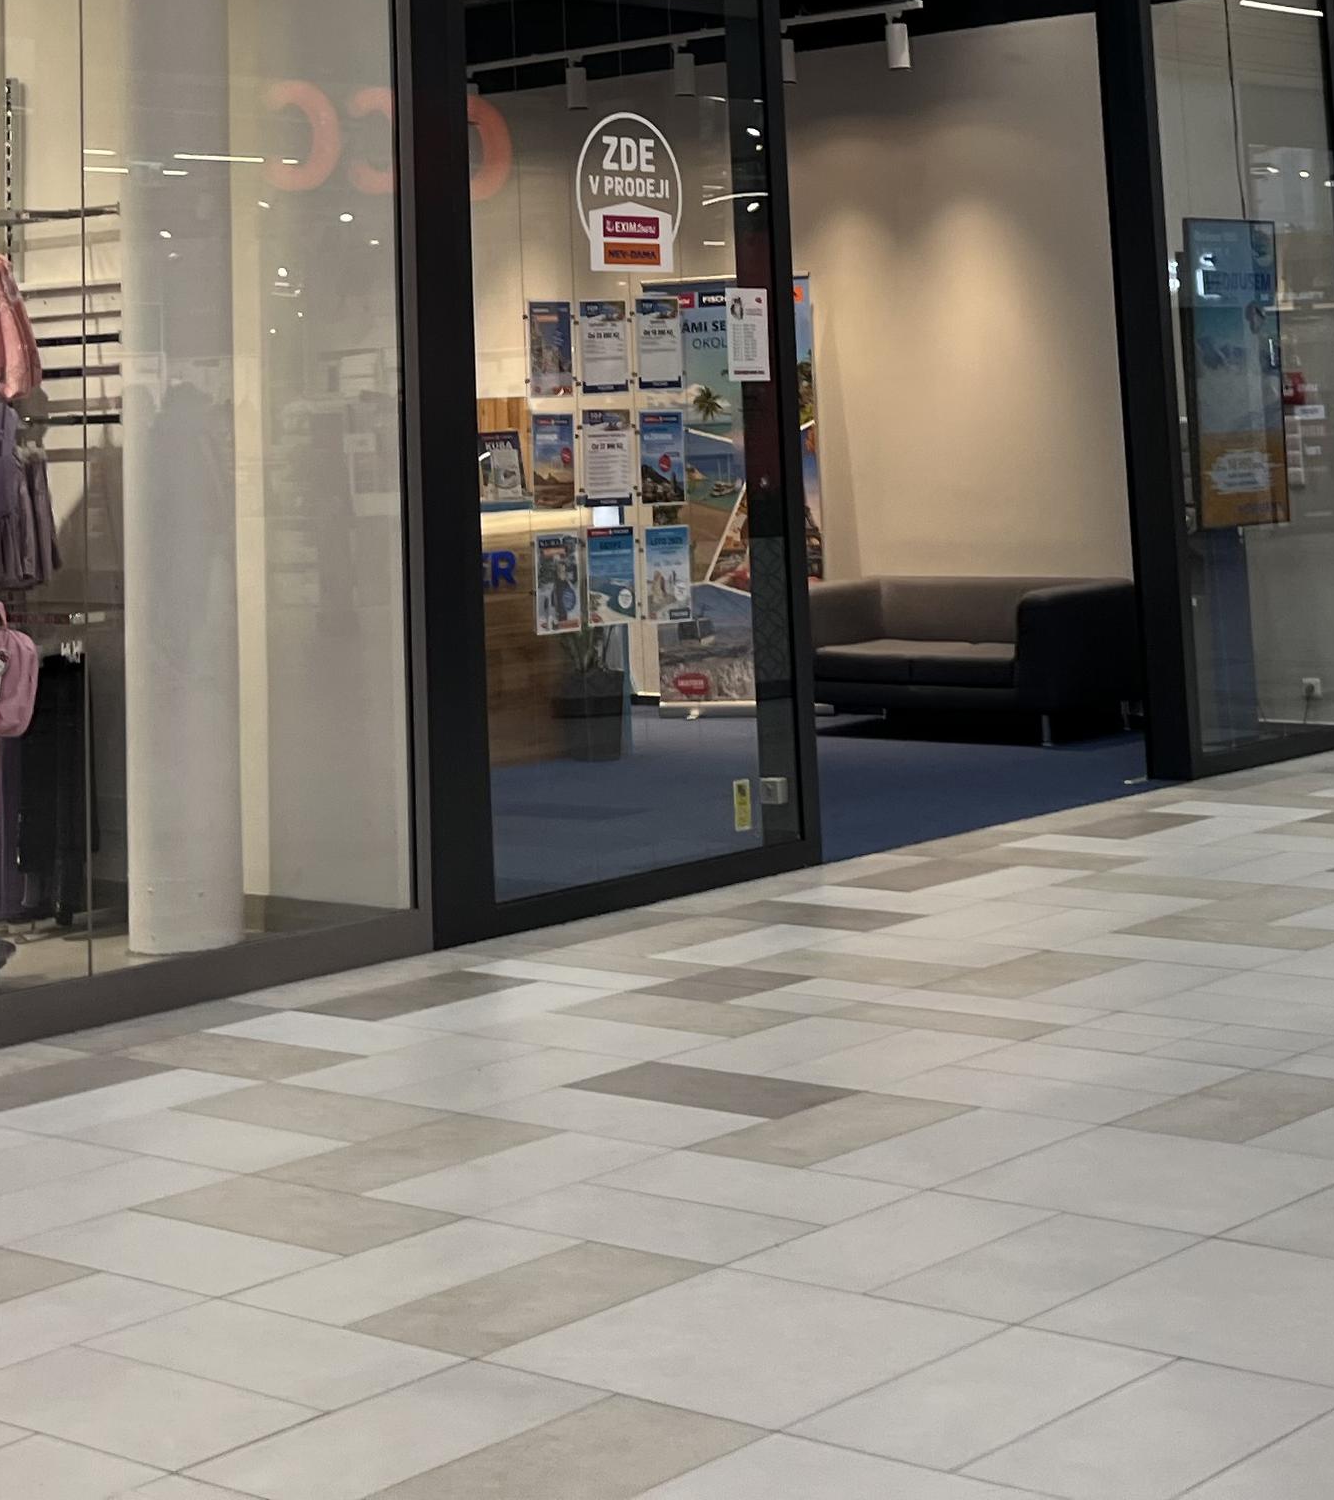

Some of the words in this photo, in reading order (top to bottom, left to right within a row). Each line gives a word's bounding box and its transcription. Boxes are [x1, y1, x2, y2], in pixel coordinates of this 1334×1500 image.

[601, 134, 656, 173] ZDE
[588, 174, 600, 196] V
[603, 175, 670, 199] PRODEJI
